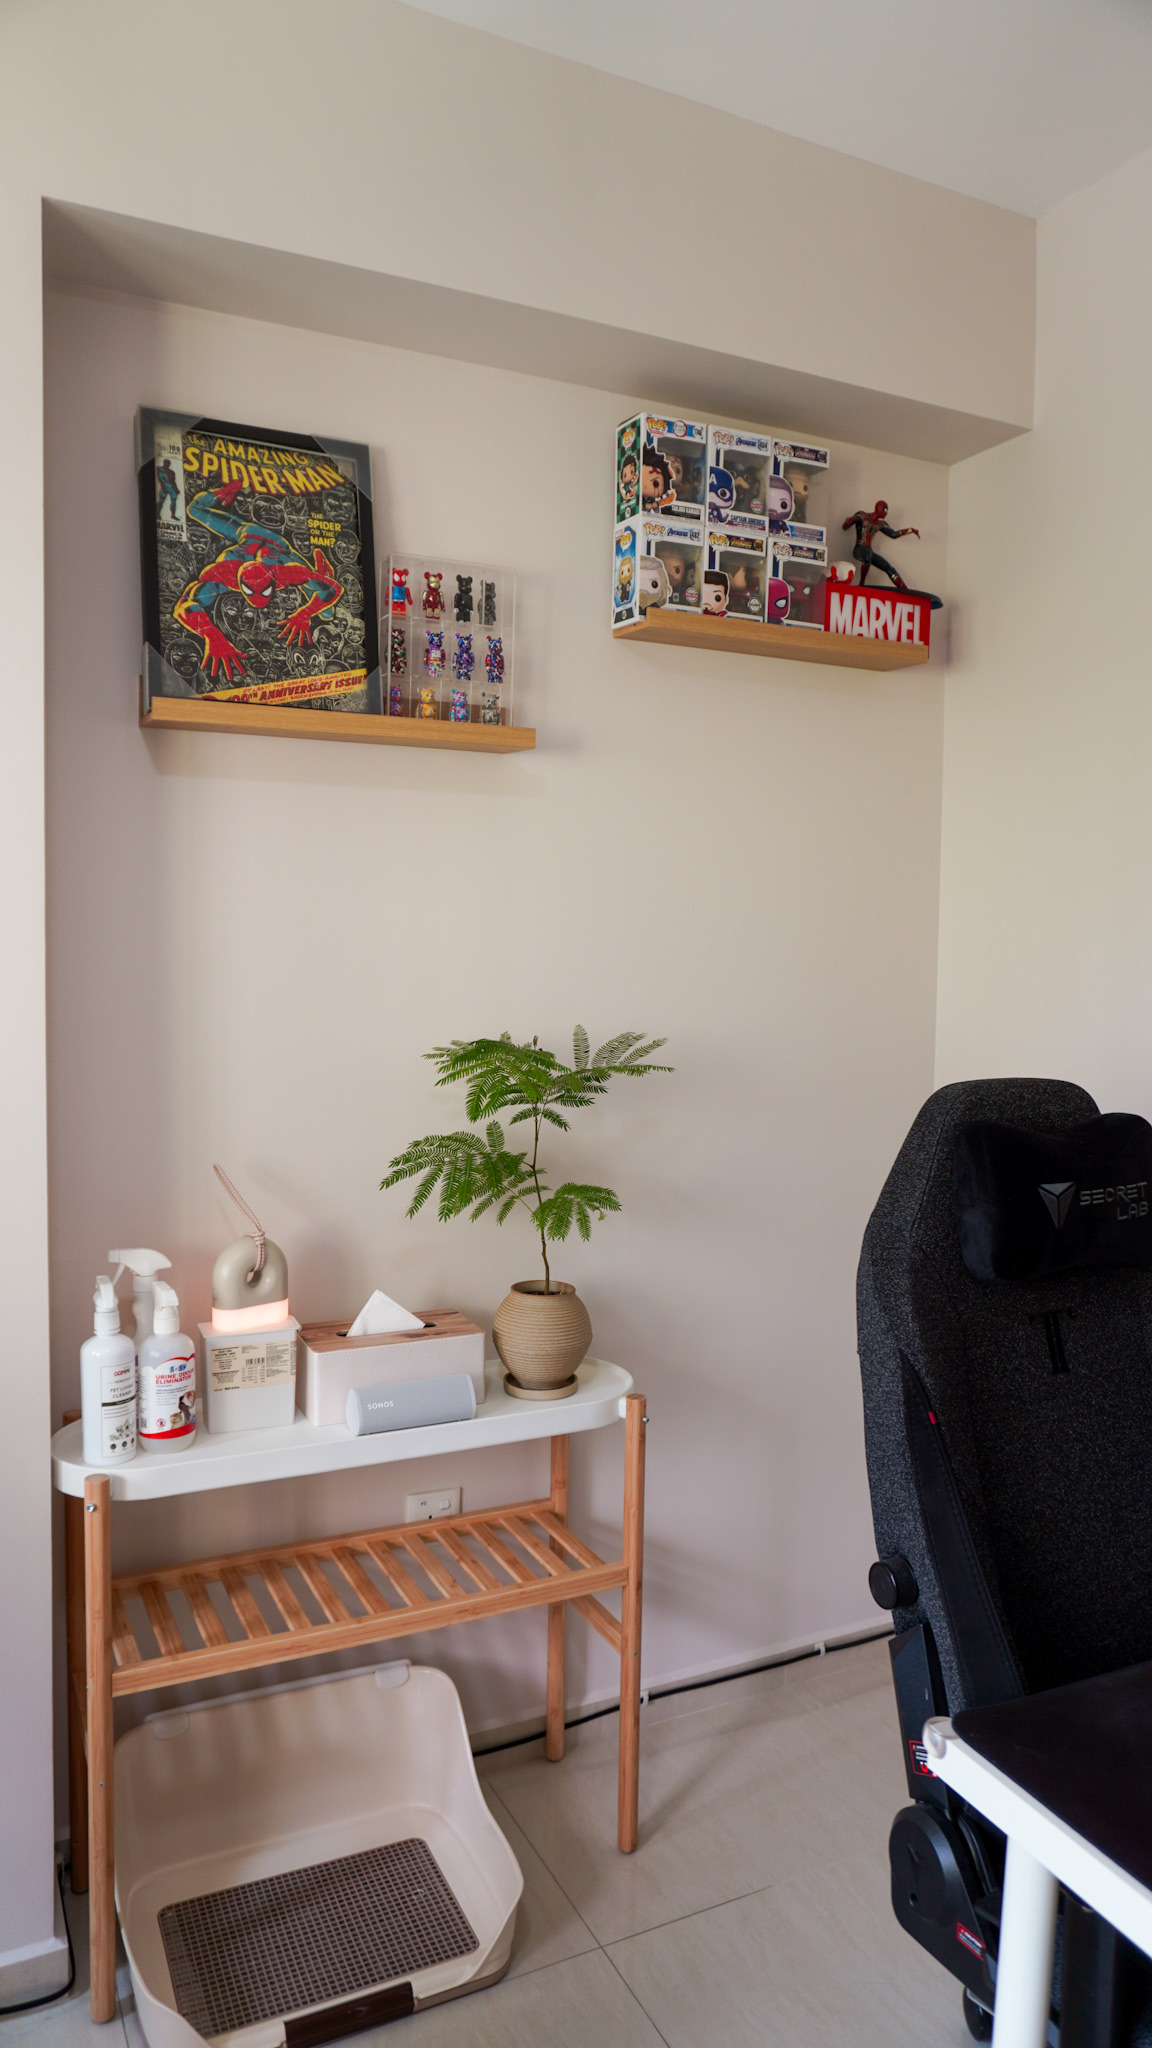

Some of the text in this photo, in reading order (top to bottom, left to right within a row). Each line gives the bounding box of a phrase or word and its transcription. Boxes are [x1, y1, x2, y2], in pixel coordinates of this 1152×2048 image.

[213, 438, 309, 466] AMAZING
[307, 519, 342, 532] SPIDER
[643, 523, 665, 537] POP!
[310, 536, 336, 548] MAN?
[708, 534, 729, 547] POP!
[829, 591, 925, 646] MARVEL
[259, 680, 333, 701] ANNIVERSARY
[1080, 1181, 1147, 1205] SECRET
[1117, 1201, 1149, 1220] LAB
[155, 1374, 192, 1385] ELIMINATOR
[367, 1400, 394, 1411] SONOS
